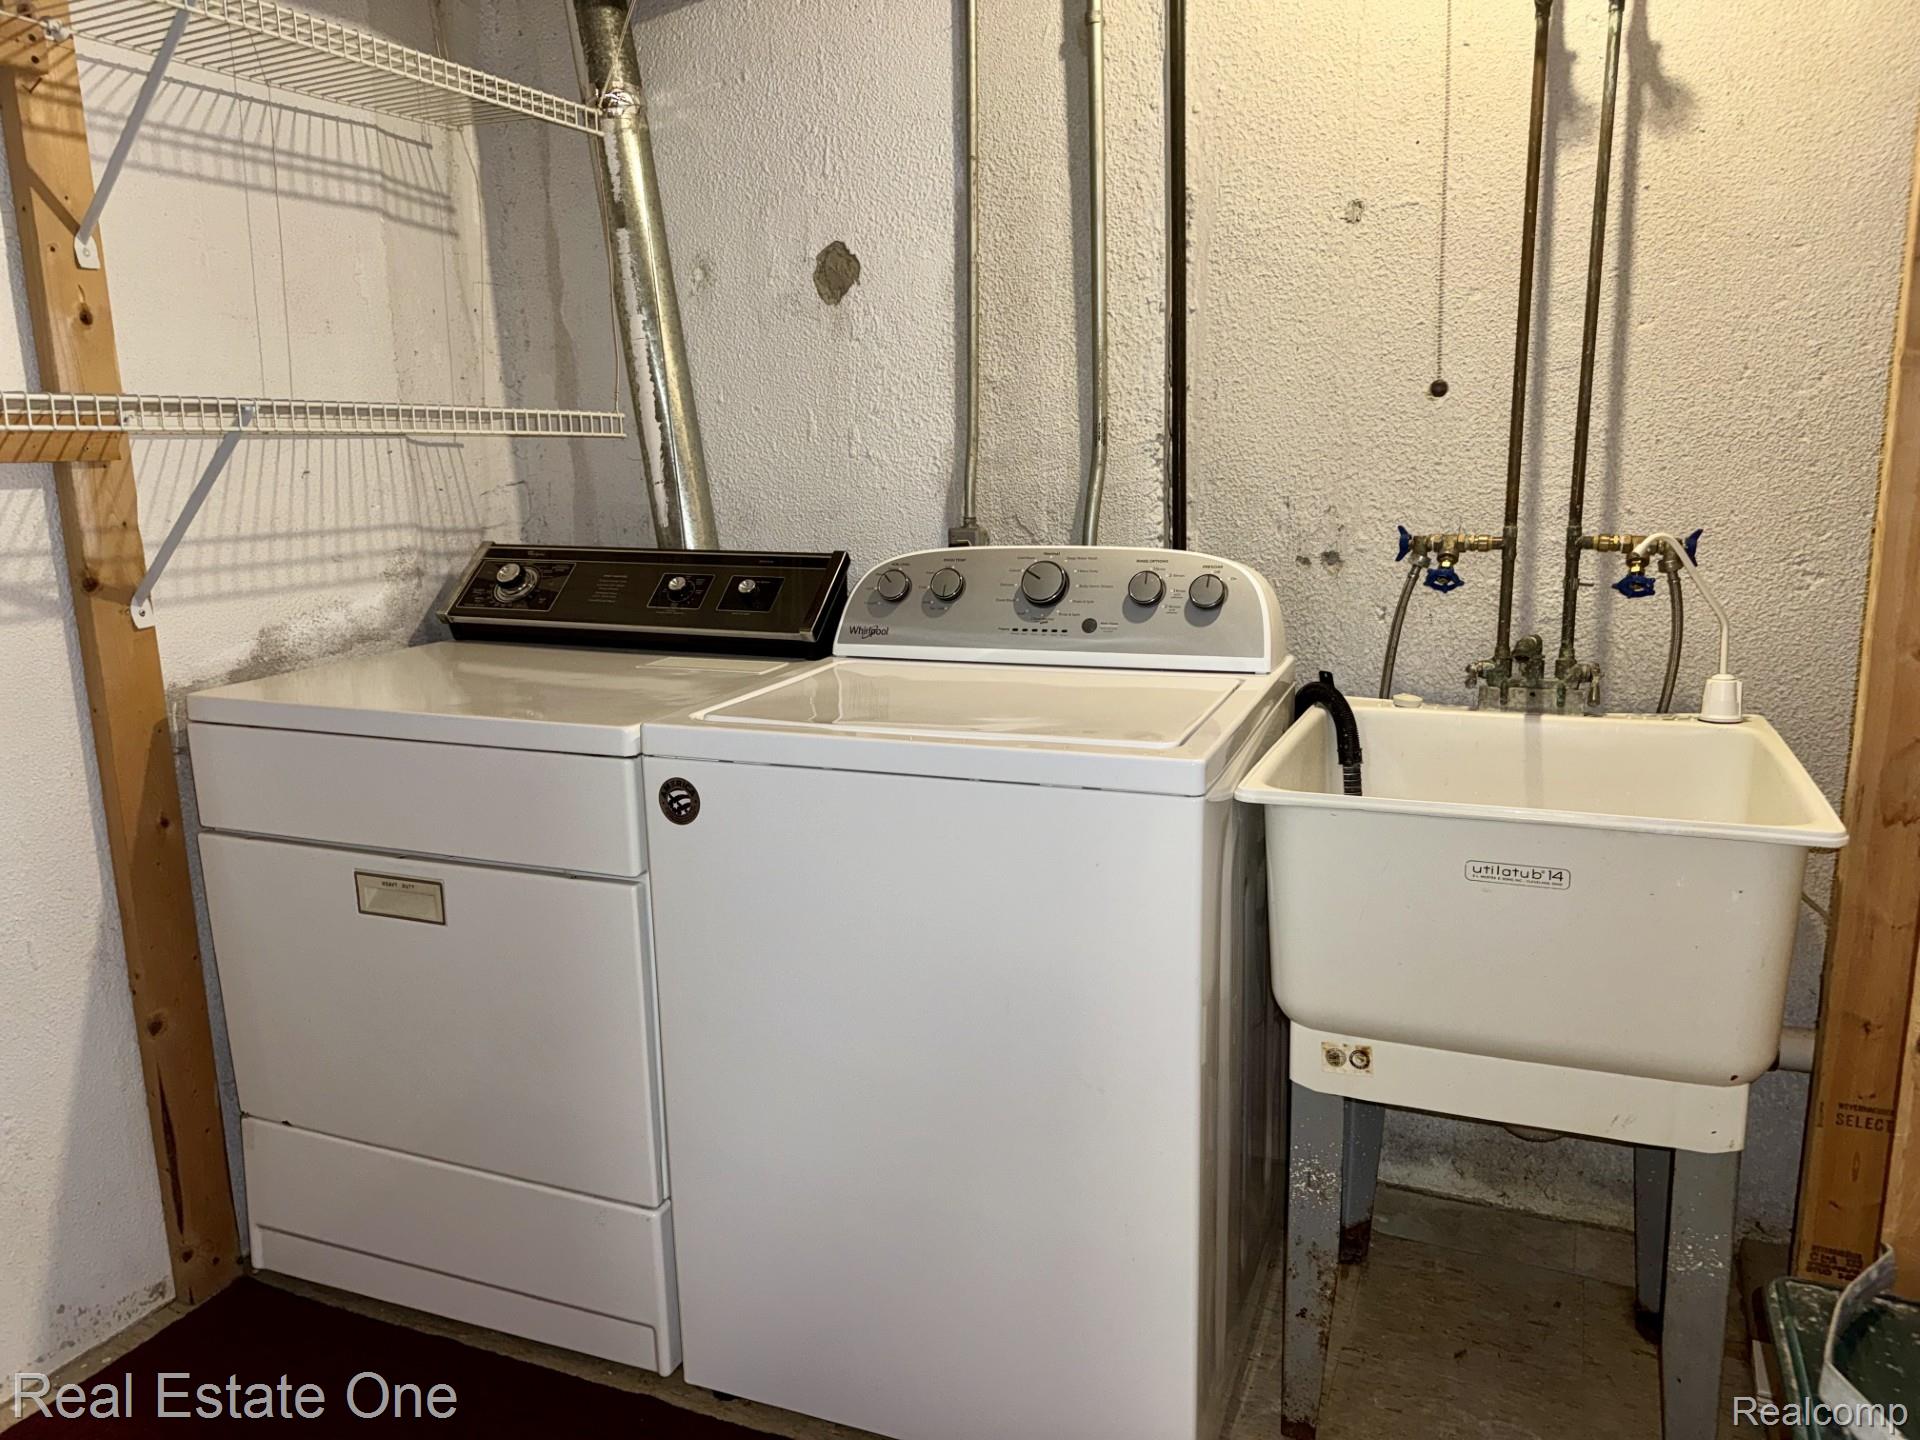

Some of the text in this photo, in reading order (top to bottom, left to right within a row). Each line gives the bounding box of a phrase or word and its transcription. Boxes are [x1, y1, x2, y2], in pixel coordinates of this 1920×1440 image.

[849, 625, 889, 639] Whirlpool
[1548, 870, 1564, 882] 14
[1835, 1113, 1895, 1133] SELECT
